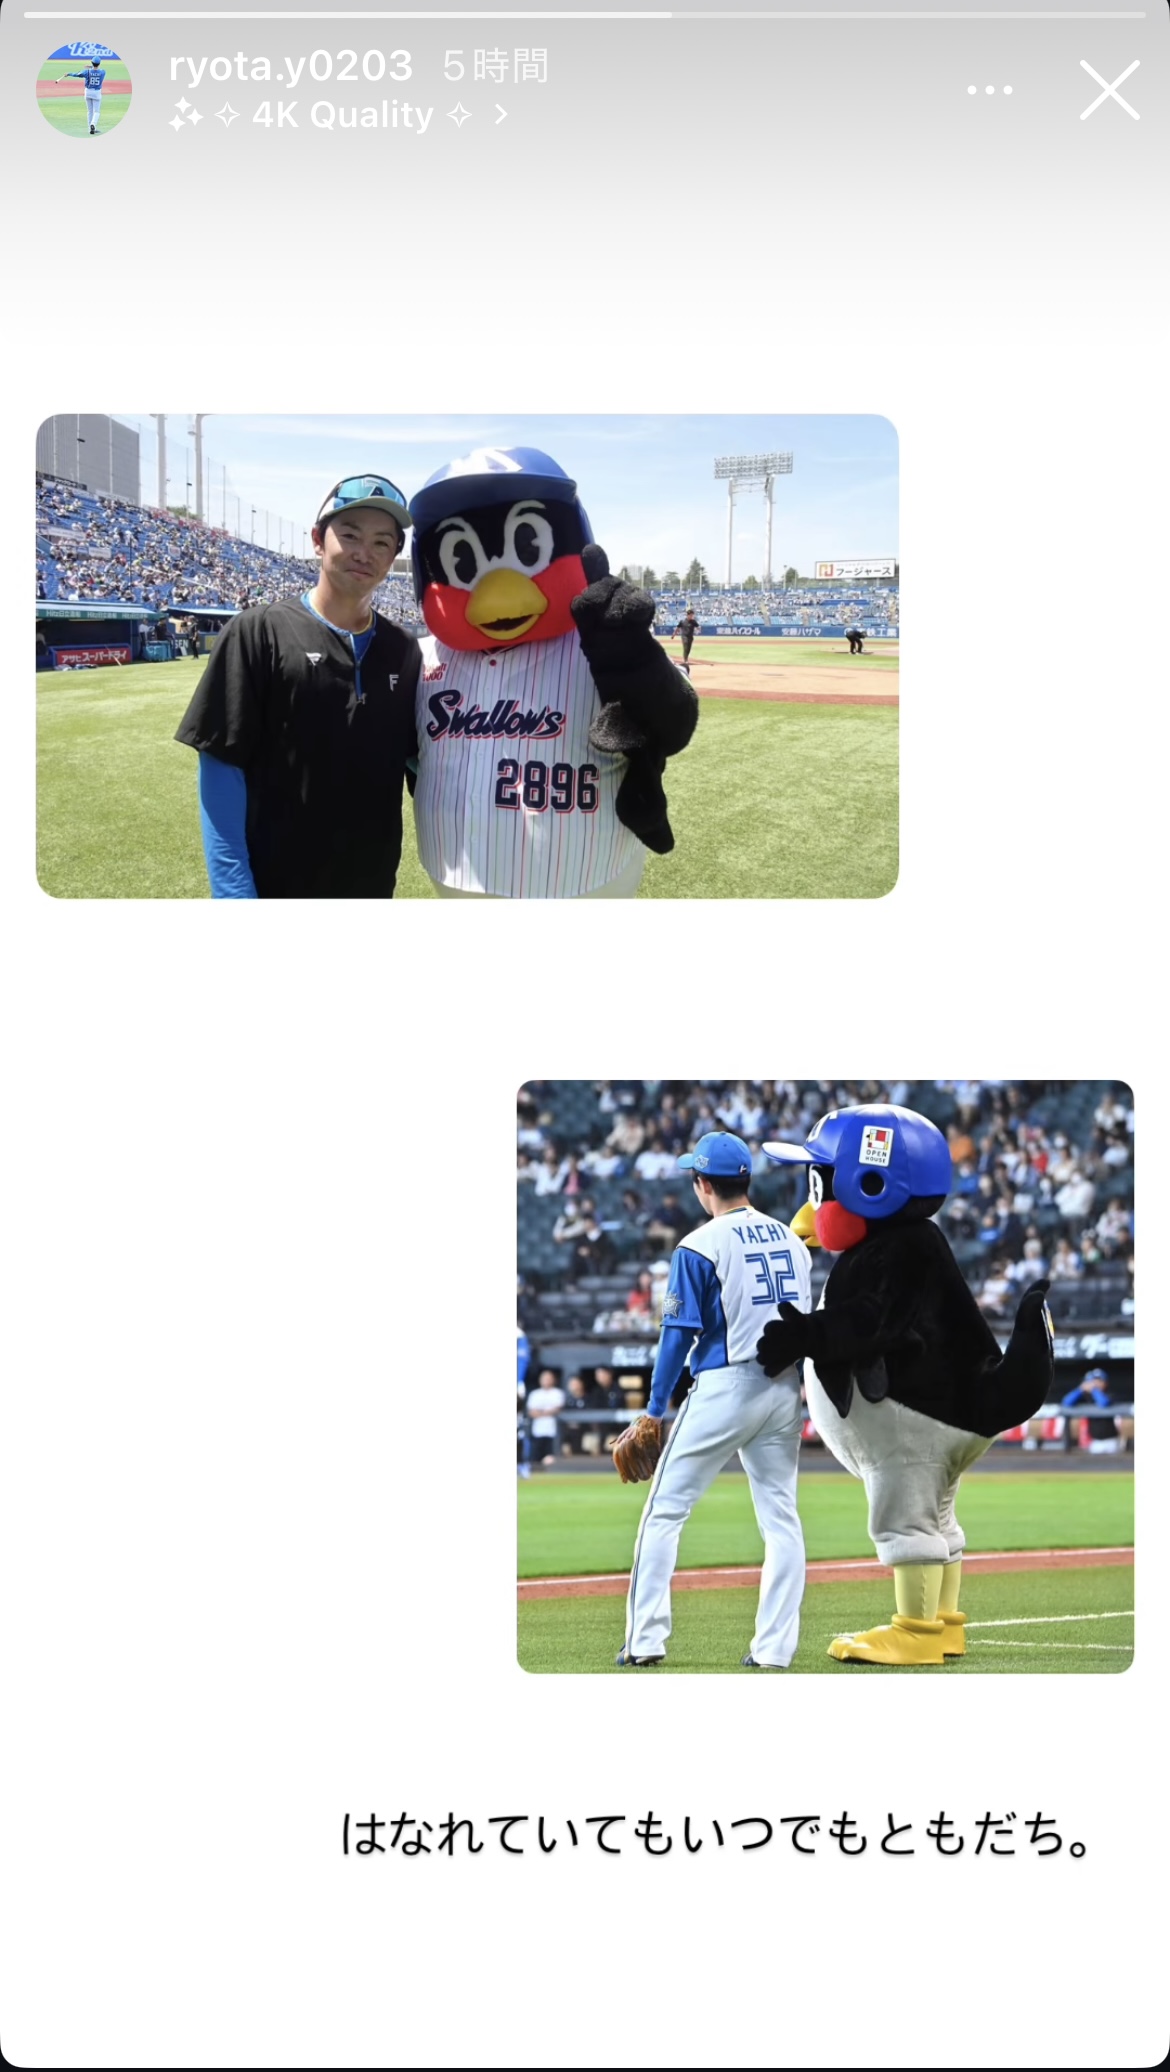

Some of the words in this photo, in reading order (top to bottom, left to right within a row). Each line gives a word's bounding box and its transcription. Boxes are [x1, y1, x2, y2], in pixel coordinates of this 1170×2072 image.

[836, 566, 892, 577] フージャース
[426, 689, 567, 741] Swallows
[495, 758, 600, 814] 2896
[865, 1156, 886, 1164] HOUSE
[866, 1149, 887, 1157] OPEN
[732, 1223, 788, 1245] YACHI
[744, 1249, 799, 1306] 32
